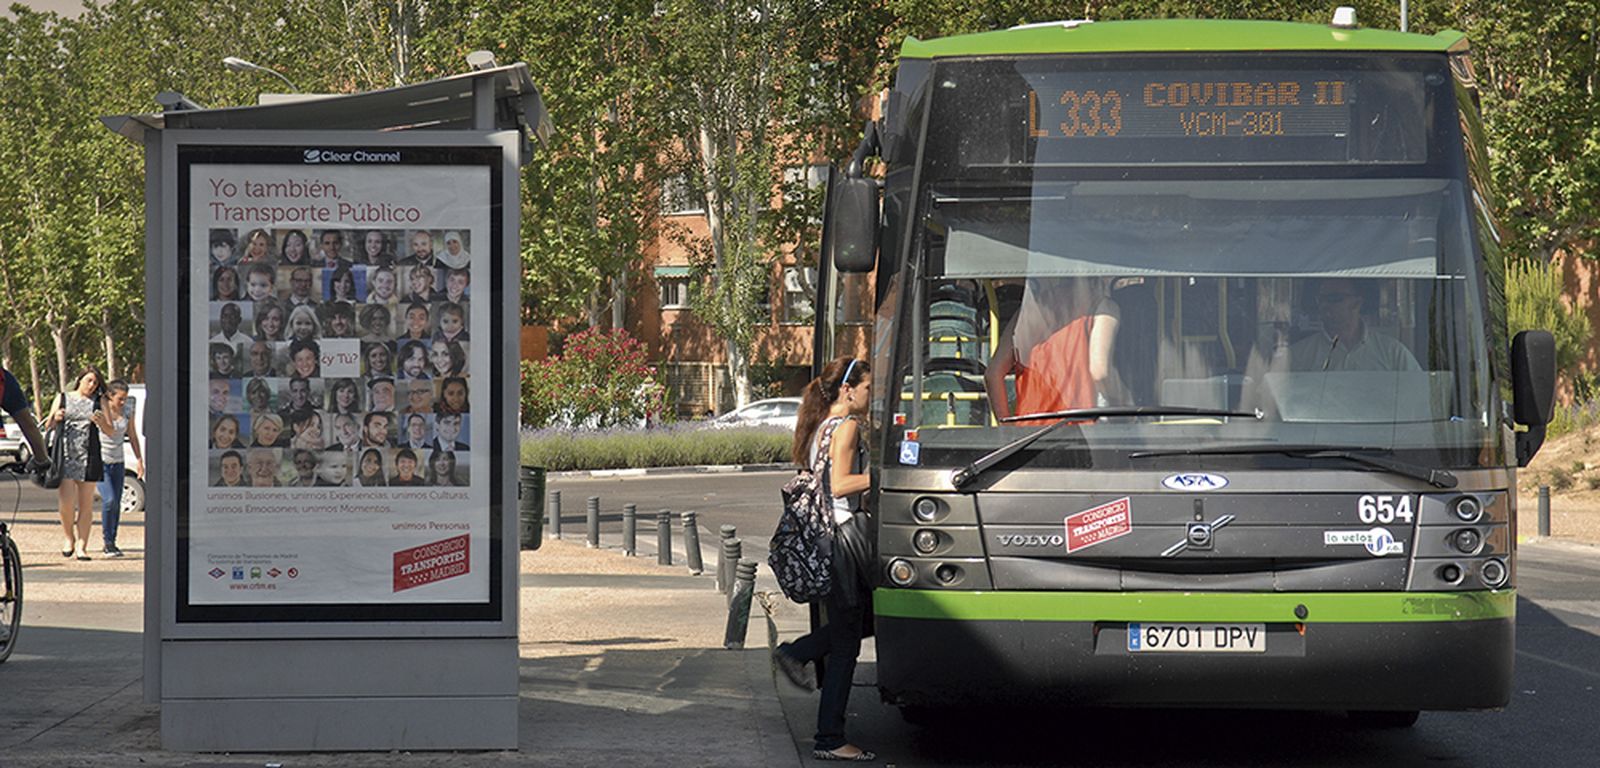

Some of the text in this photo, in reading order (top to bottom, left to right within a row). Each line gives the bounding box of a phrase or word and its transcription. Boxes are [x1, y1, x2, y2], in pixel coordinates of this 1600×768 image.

[1143, 81, 1300, 107] COVIBAR
[1028, 89, 1122, 137] L 333
[1179, 110, 1286, 136] VCM-301
[320, 151, 400, 162] Clear Channel
[209, 178, 342, 200] Yo también,
[209, 202, 421, 224] Transporte Público
[207, 492, 242, 500] unimos
[291, 492, 327, 500] unimos
[391, 491, 427, 500] unimos
[206, 505, 243, 514] unimos
[302, 505, 338, 513] unimos
[1358, 494, 1413, 524] 654
[391, 521, 470, 531] unimos Personas
[413, 537, 466, 560] CONSORCIO
[996, 534, 1063, 547] VOLVO
[1342, 533, 1373, 543] veloz
[401, 550, 466, 576] TRANSPORTES
[430, 562, 466, 581] MADRID
[1146, 626, 1258, 648] 6701 DPV
